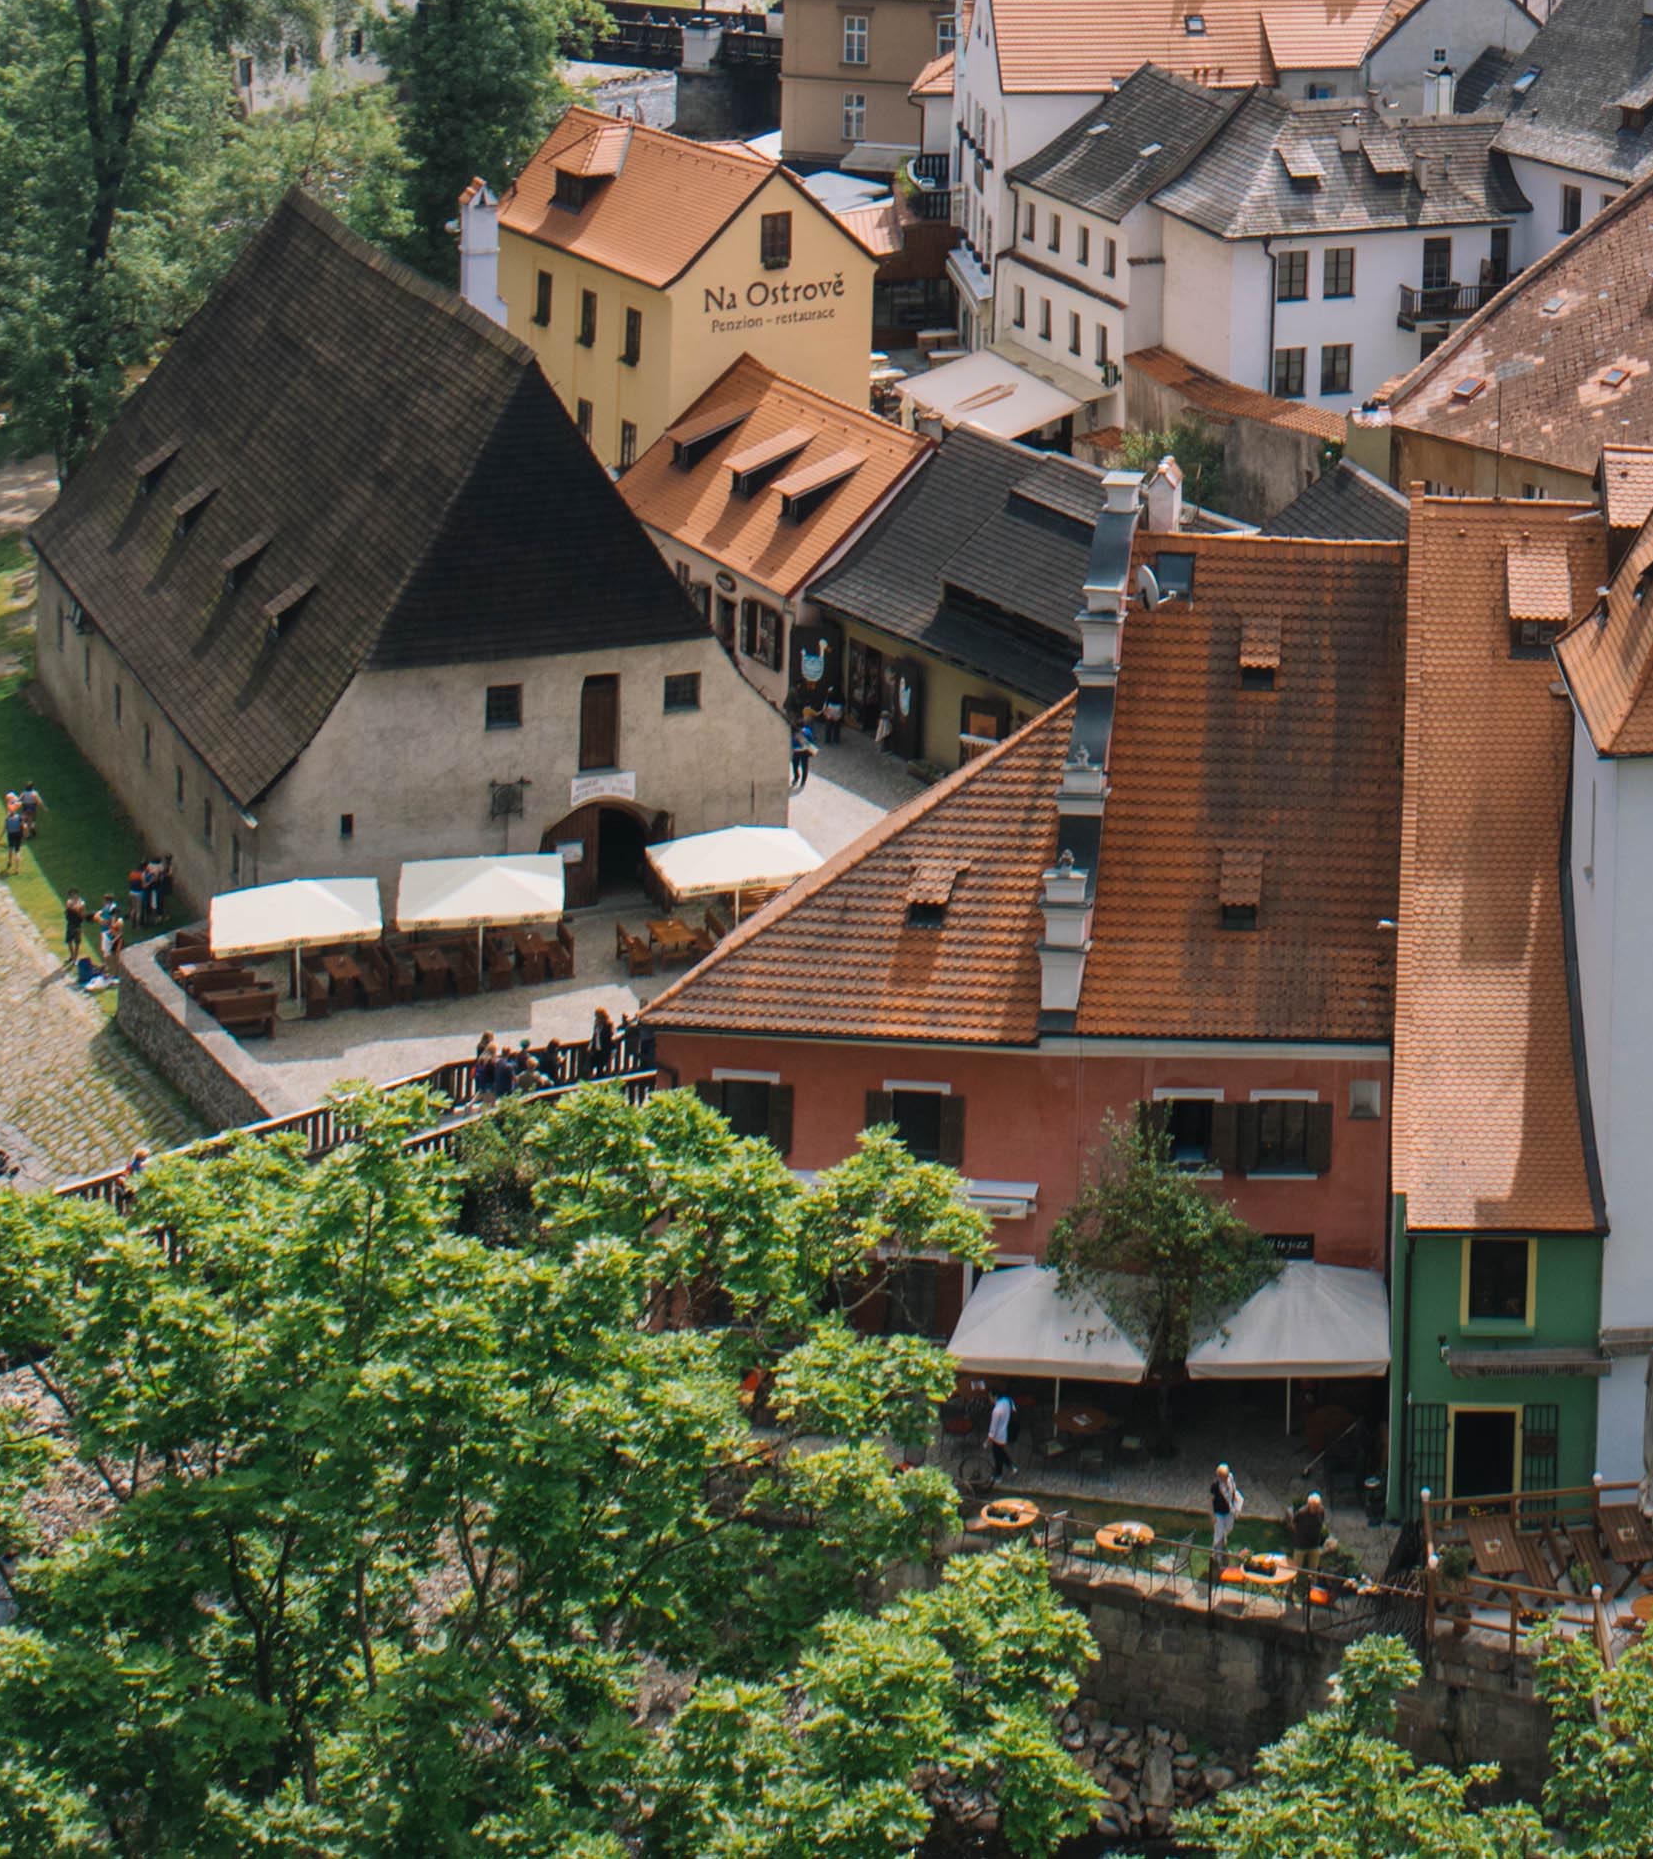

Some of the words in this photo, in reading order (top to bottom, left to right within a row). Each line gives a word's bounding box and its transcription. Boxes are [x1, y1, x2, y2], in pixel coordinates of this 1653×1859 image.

[703, 286, 737, 313] Na
[746, 272, 845, 307] Ostrově
[711, 315, 764, 333] Penzion
[775, 308, 836, 326] restaurace
